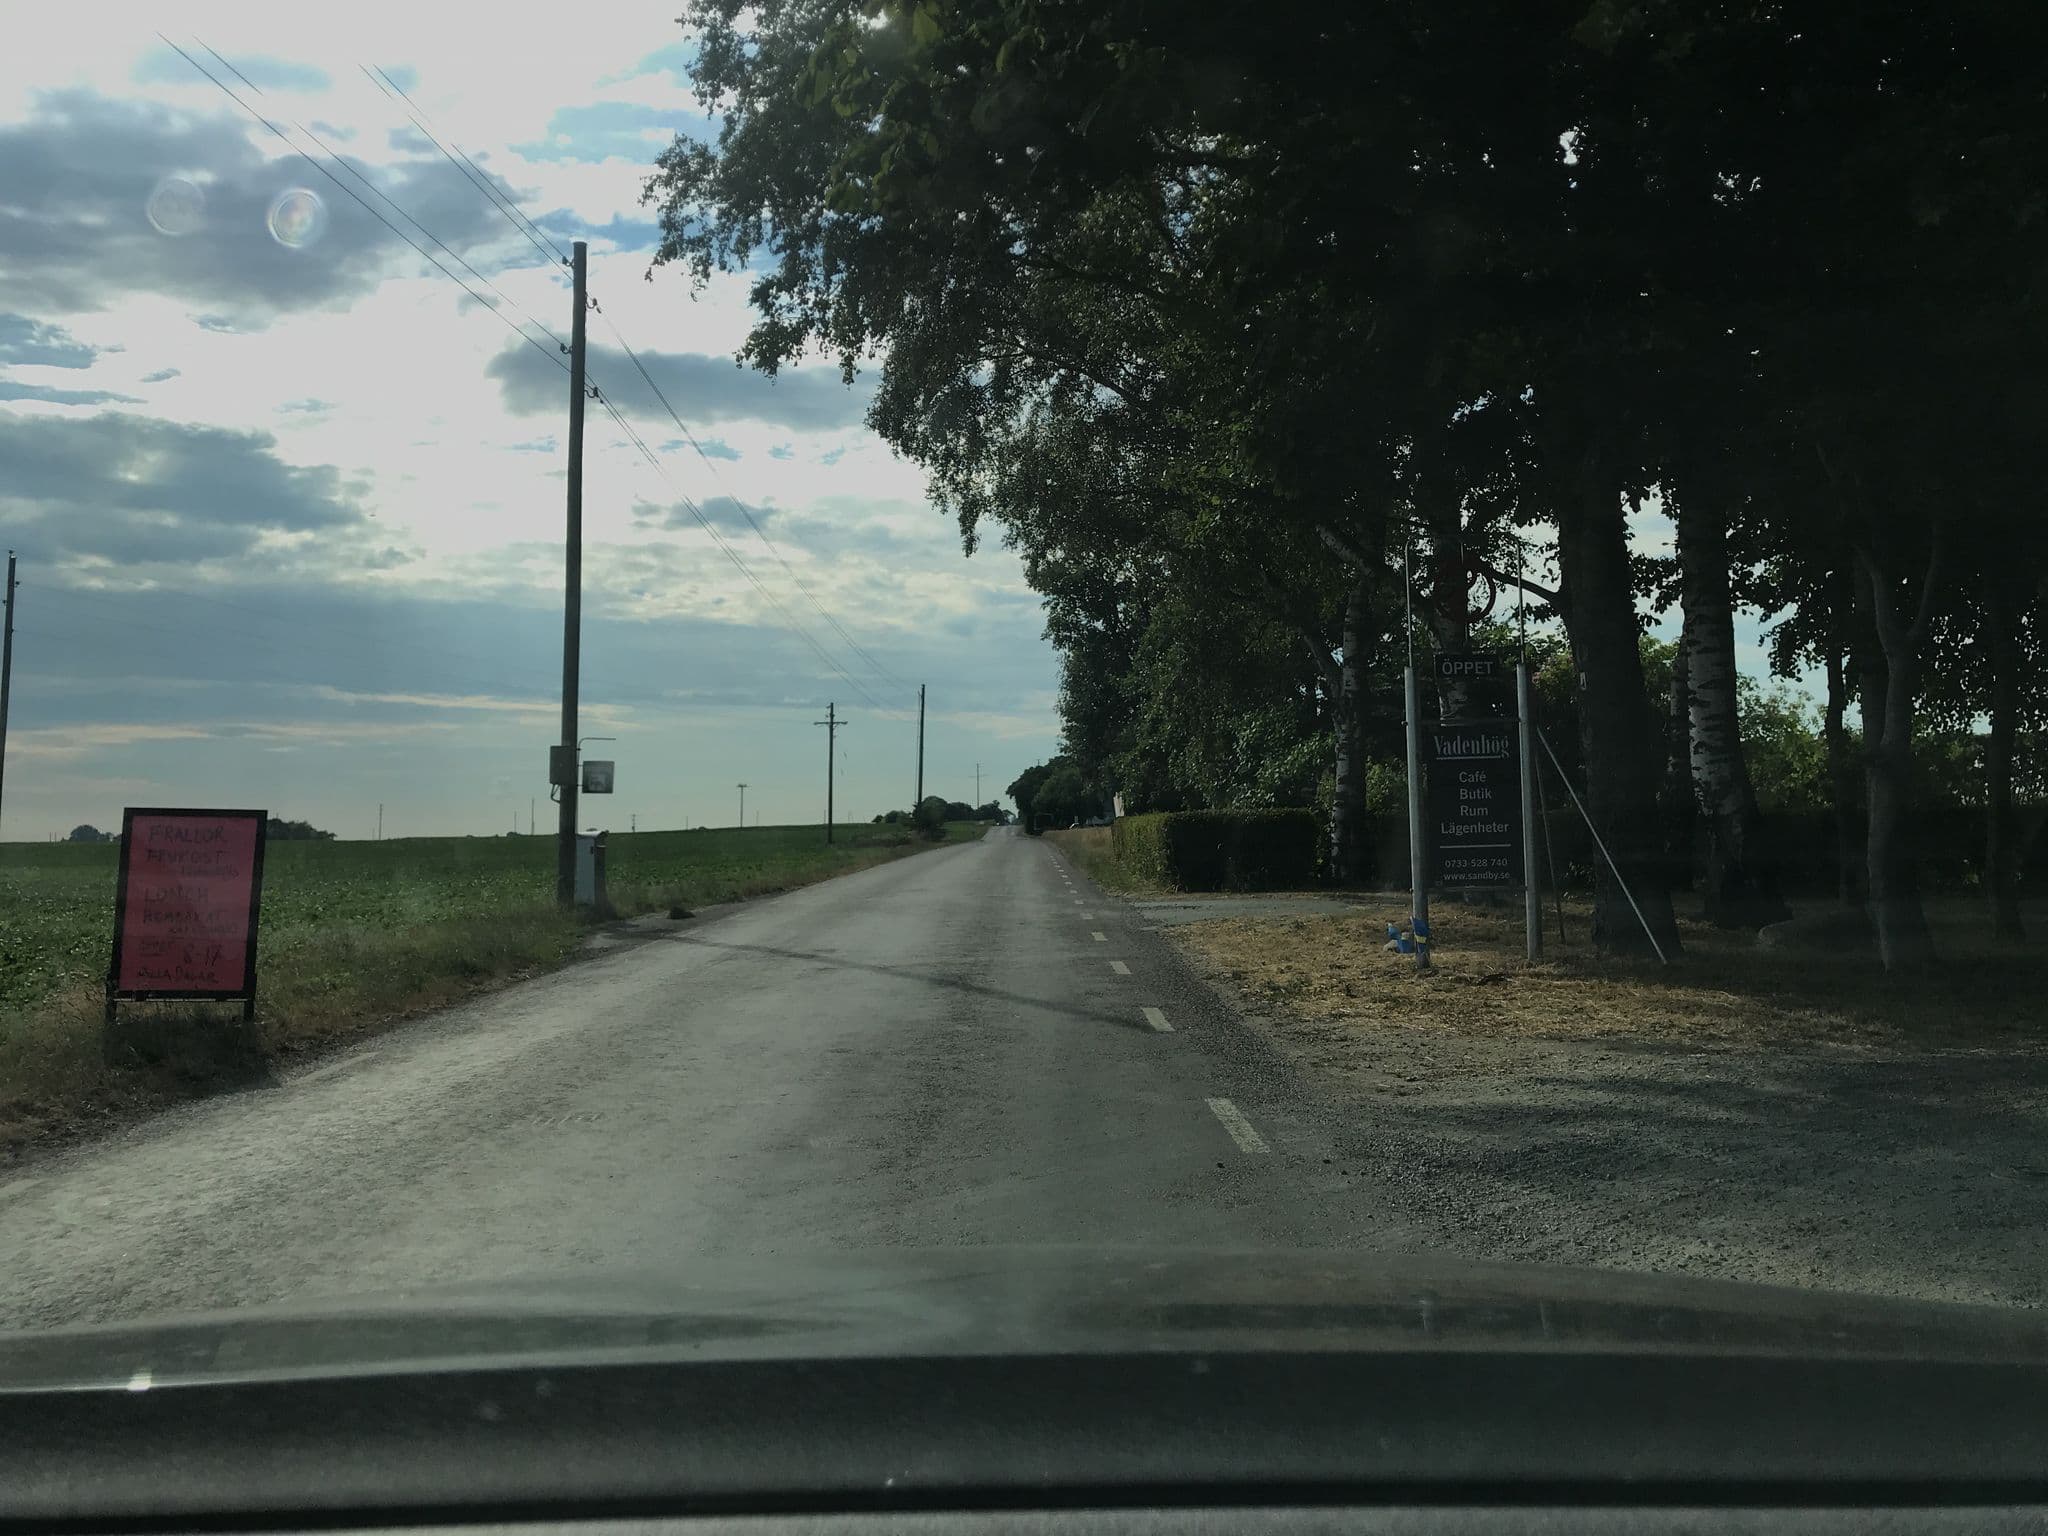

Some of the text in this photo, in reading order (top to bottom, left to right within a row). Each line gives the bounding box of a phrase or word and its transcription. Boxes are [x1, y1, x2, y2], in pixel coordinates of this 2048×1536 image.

[1442, 658, 1493, 675] ÖPPET
[1433, 735, 1510, 759] Vadenhög
[1458, 770, 1487, 783] Café
[1459, 787, 1492, 800] Butik
[1459, 805, 1489, 817] Rum
[1441, 821, 1510, 836] Lägenheter
[1444, 859, 1468, 868] 0733
